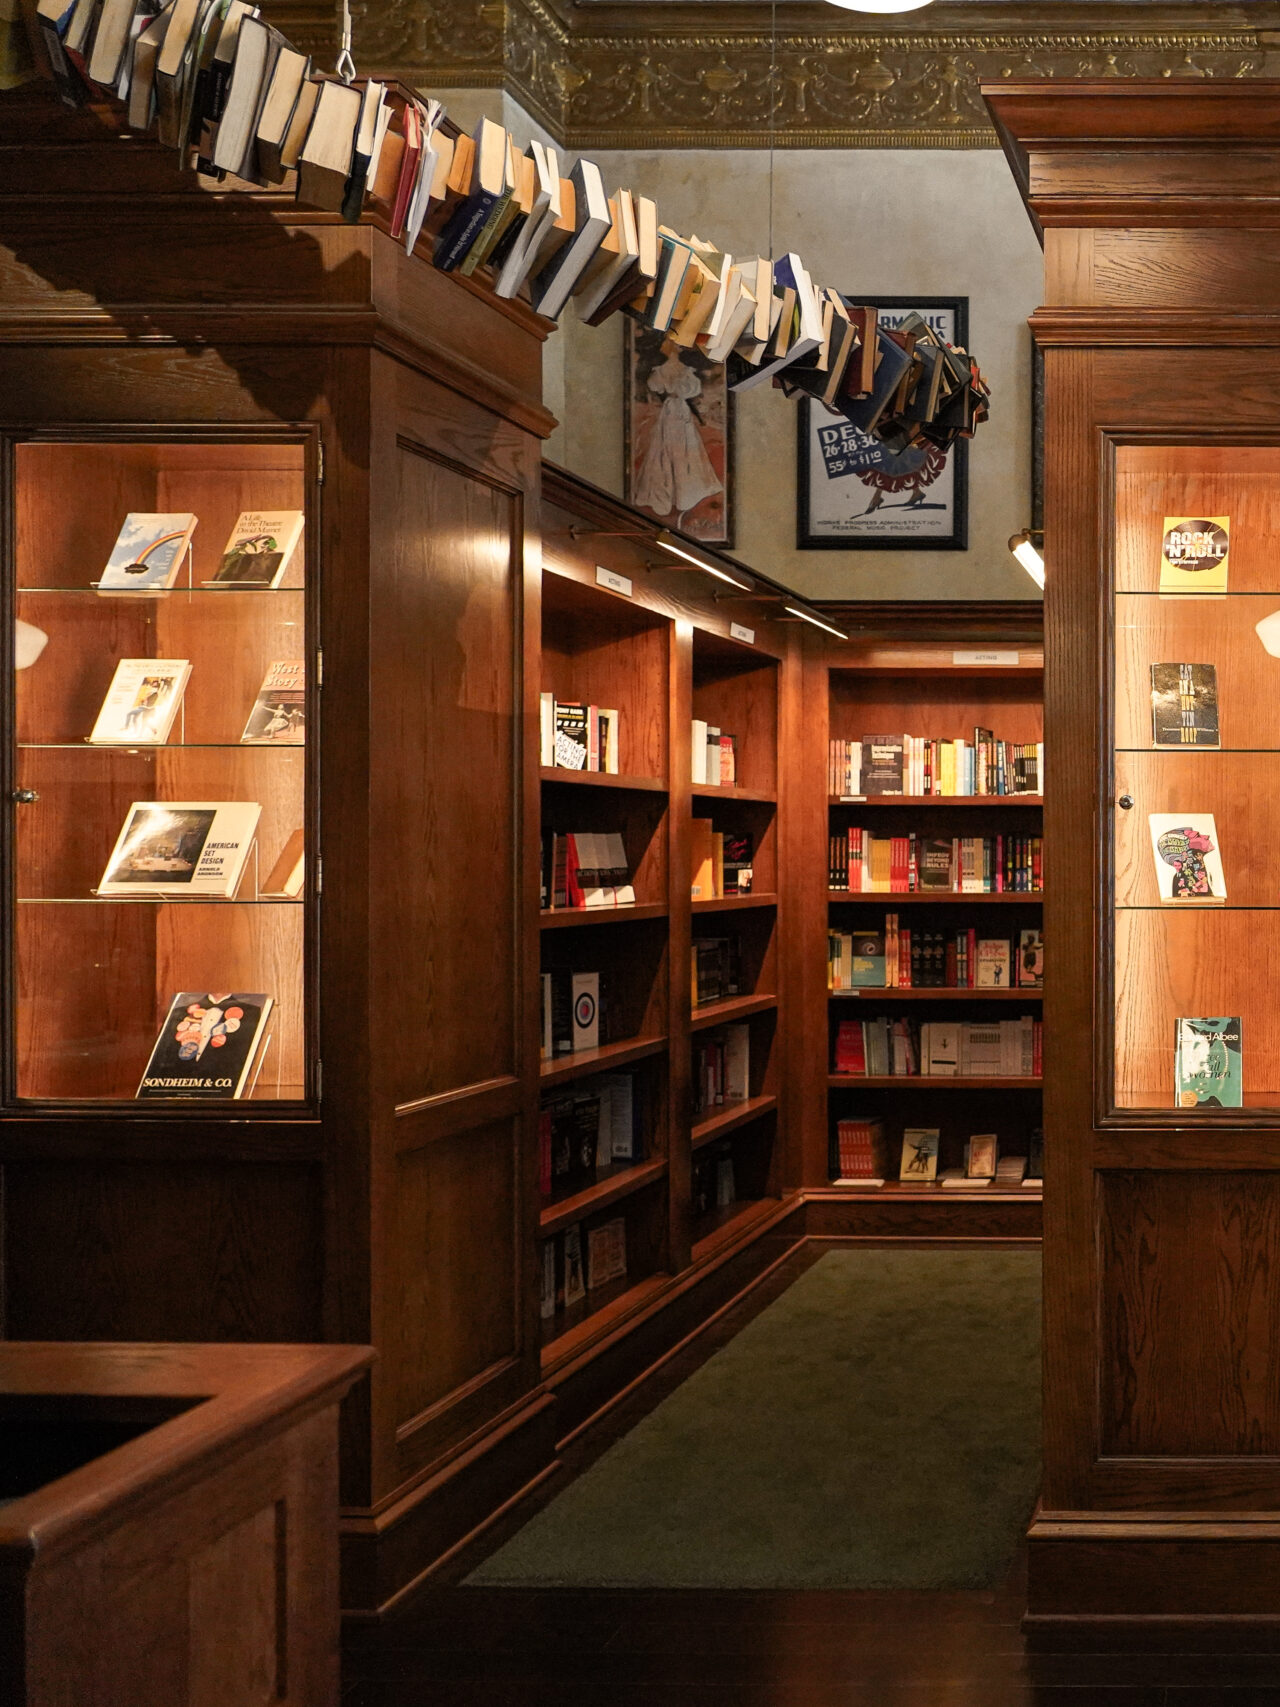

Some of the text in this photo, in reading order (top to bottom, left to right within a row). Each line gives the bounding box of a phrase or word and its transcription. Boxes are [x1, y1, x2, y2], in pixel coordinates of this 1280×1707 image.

[1170, 531, 1214, 545] ROCK
[1186, 544, 1225, 557] ROLL
[273, 662, 299, 675] West
[266, 675, 297, 689] Story
[200, 857, 224, 865] DESIGN
[1212, 1031, 1239, 1041] Albee
[142, 1078, 232, 1087] SONDHEIM & CO.
